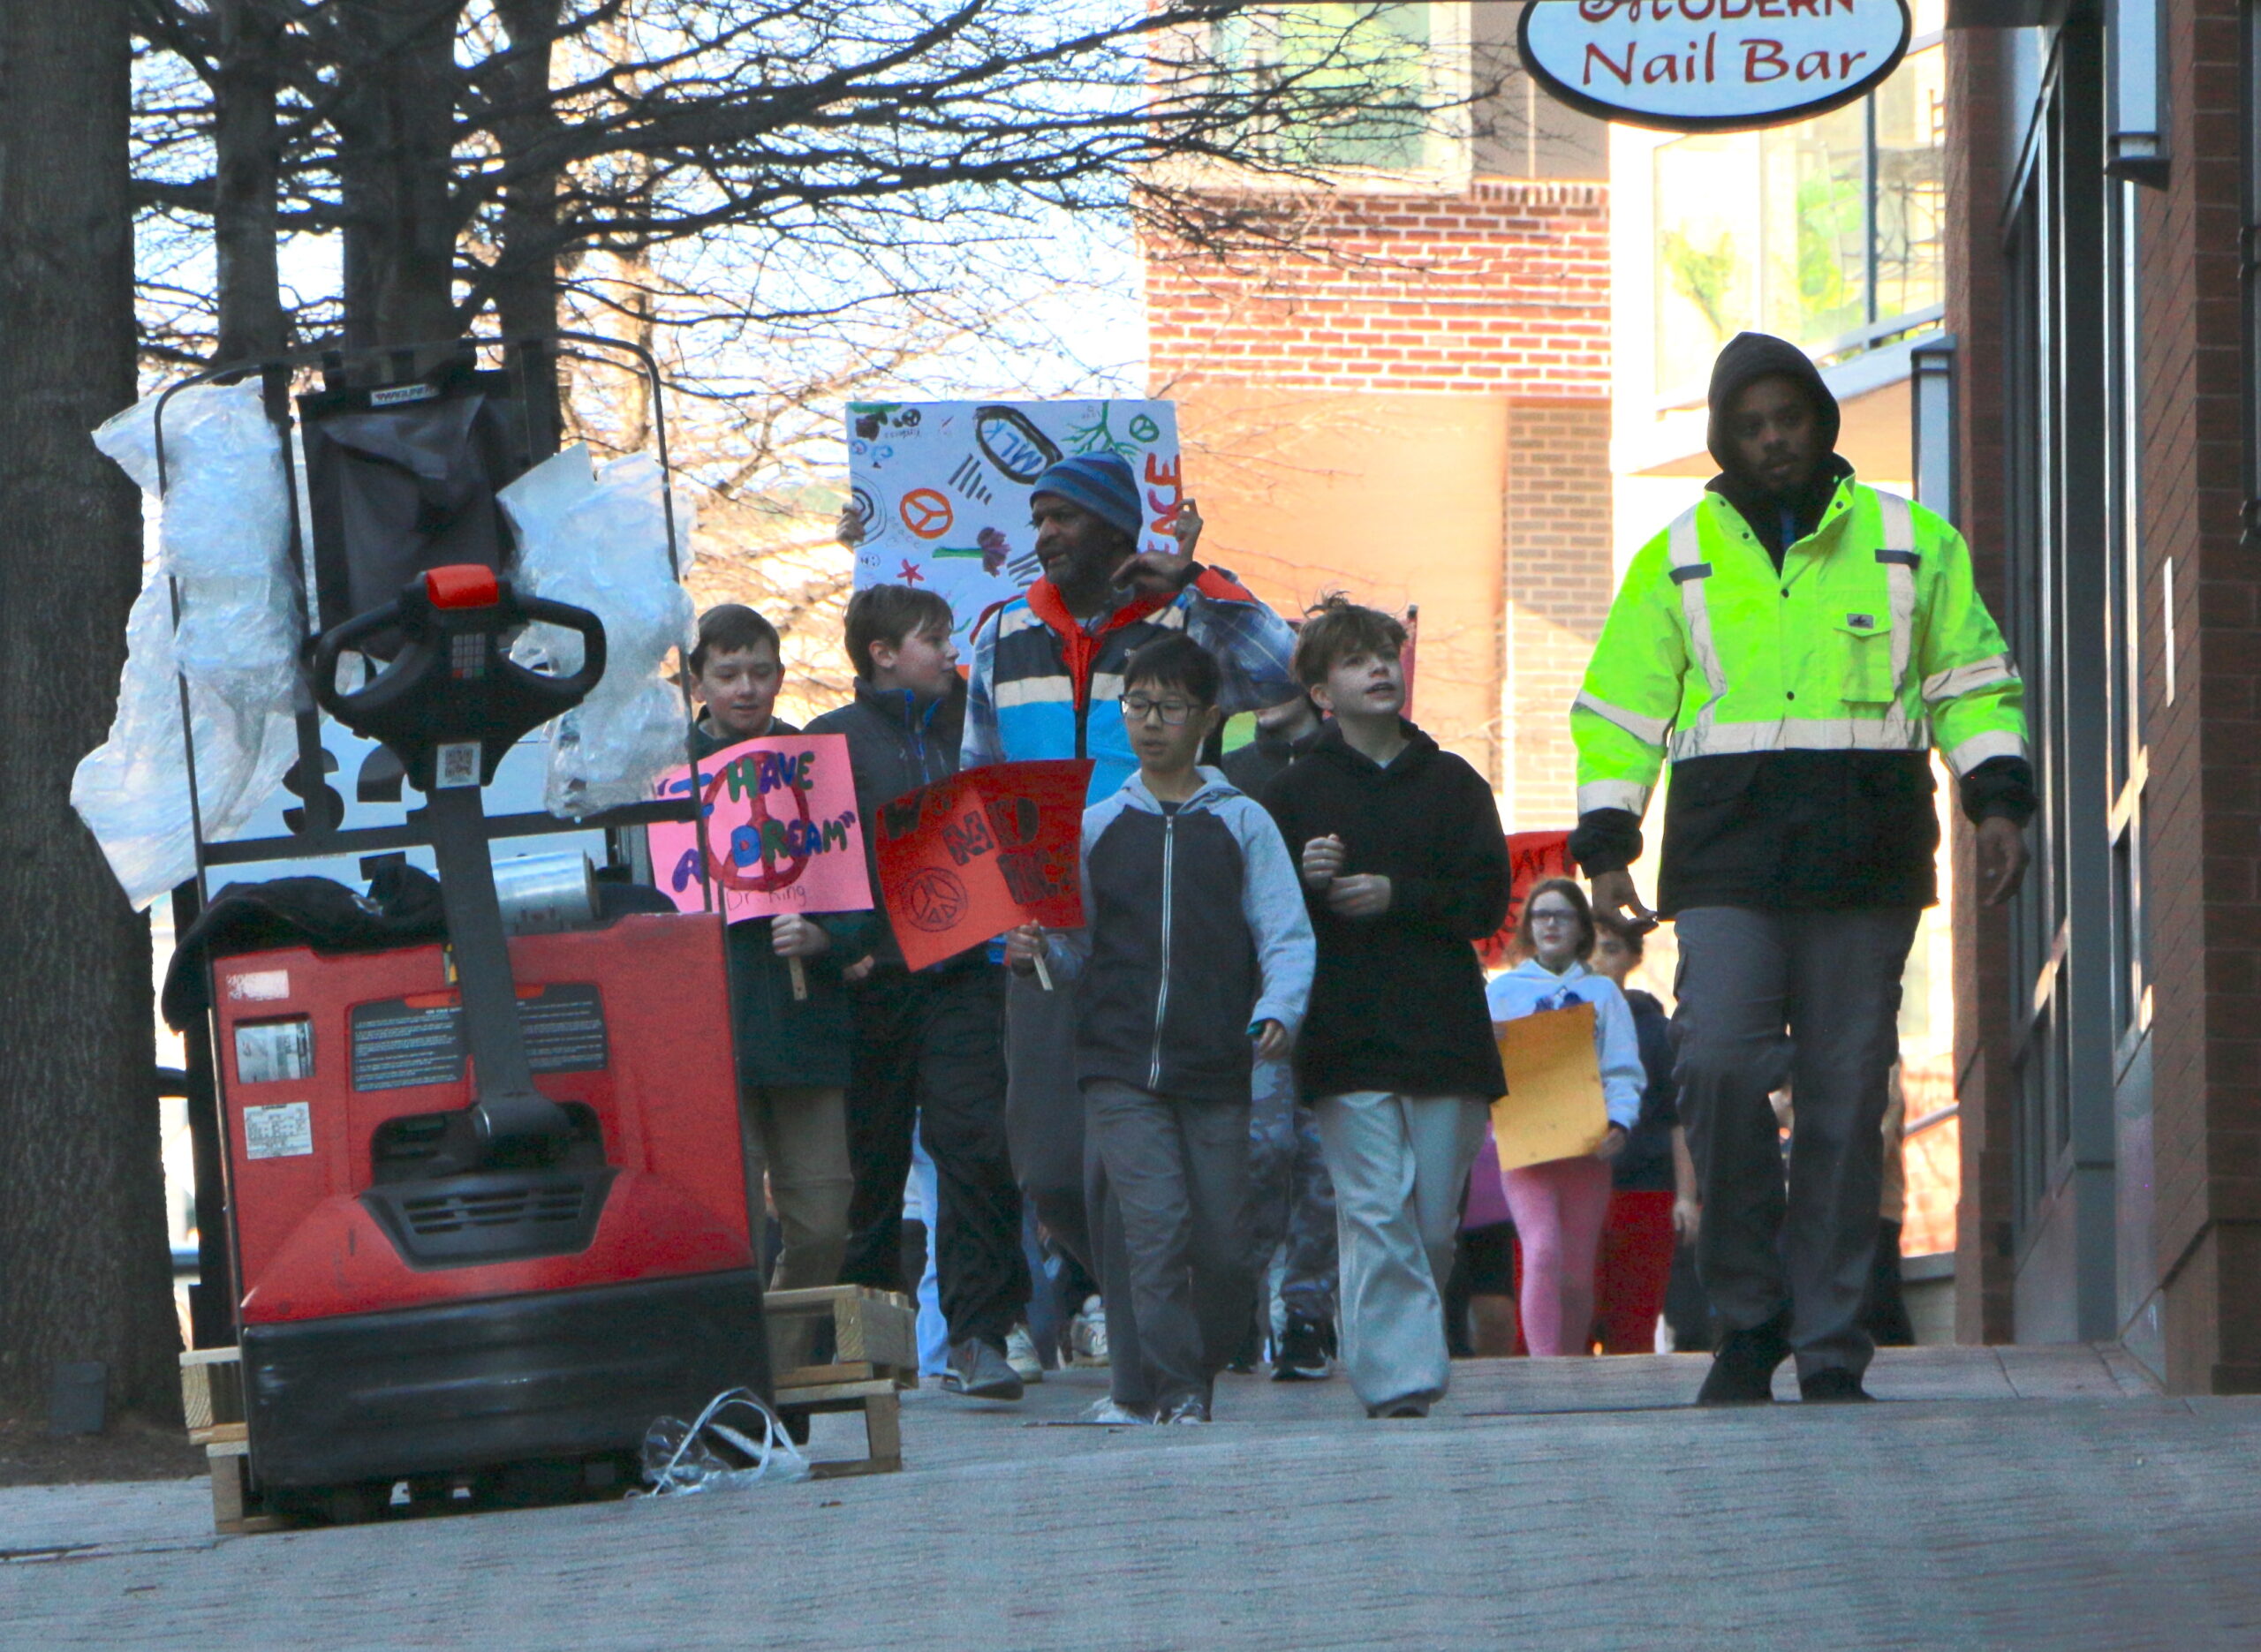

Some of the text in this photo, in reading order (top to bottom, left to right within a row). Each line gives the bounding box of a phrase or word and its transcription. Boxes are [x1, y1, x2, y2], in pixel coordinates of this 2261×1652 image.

[1583, 31, 1867, 86] Nail Bar
[983, 419, 1044, 473] MLK
[1144, 452, 1184, 554] ACE
[726, 751, 815, 803] HAVE
[671, 810, 857, 893] A DREAM"
